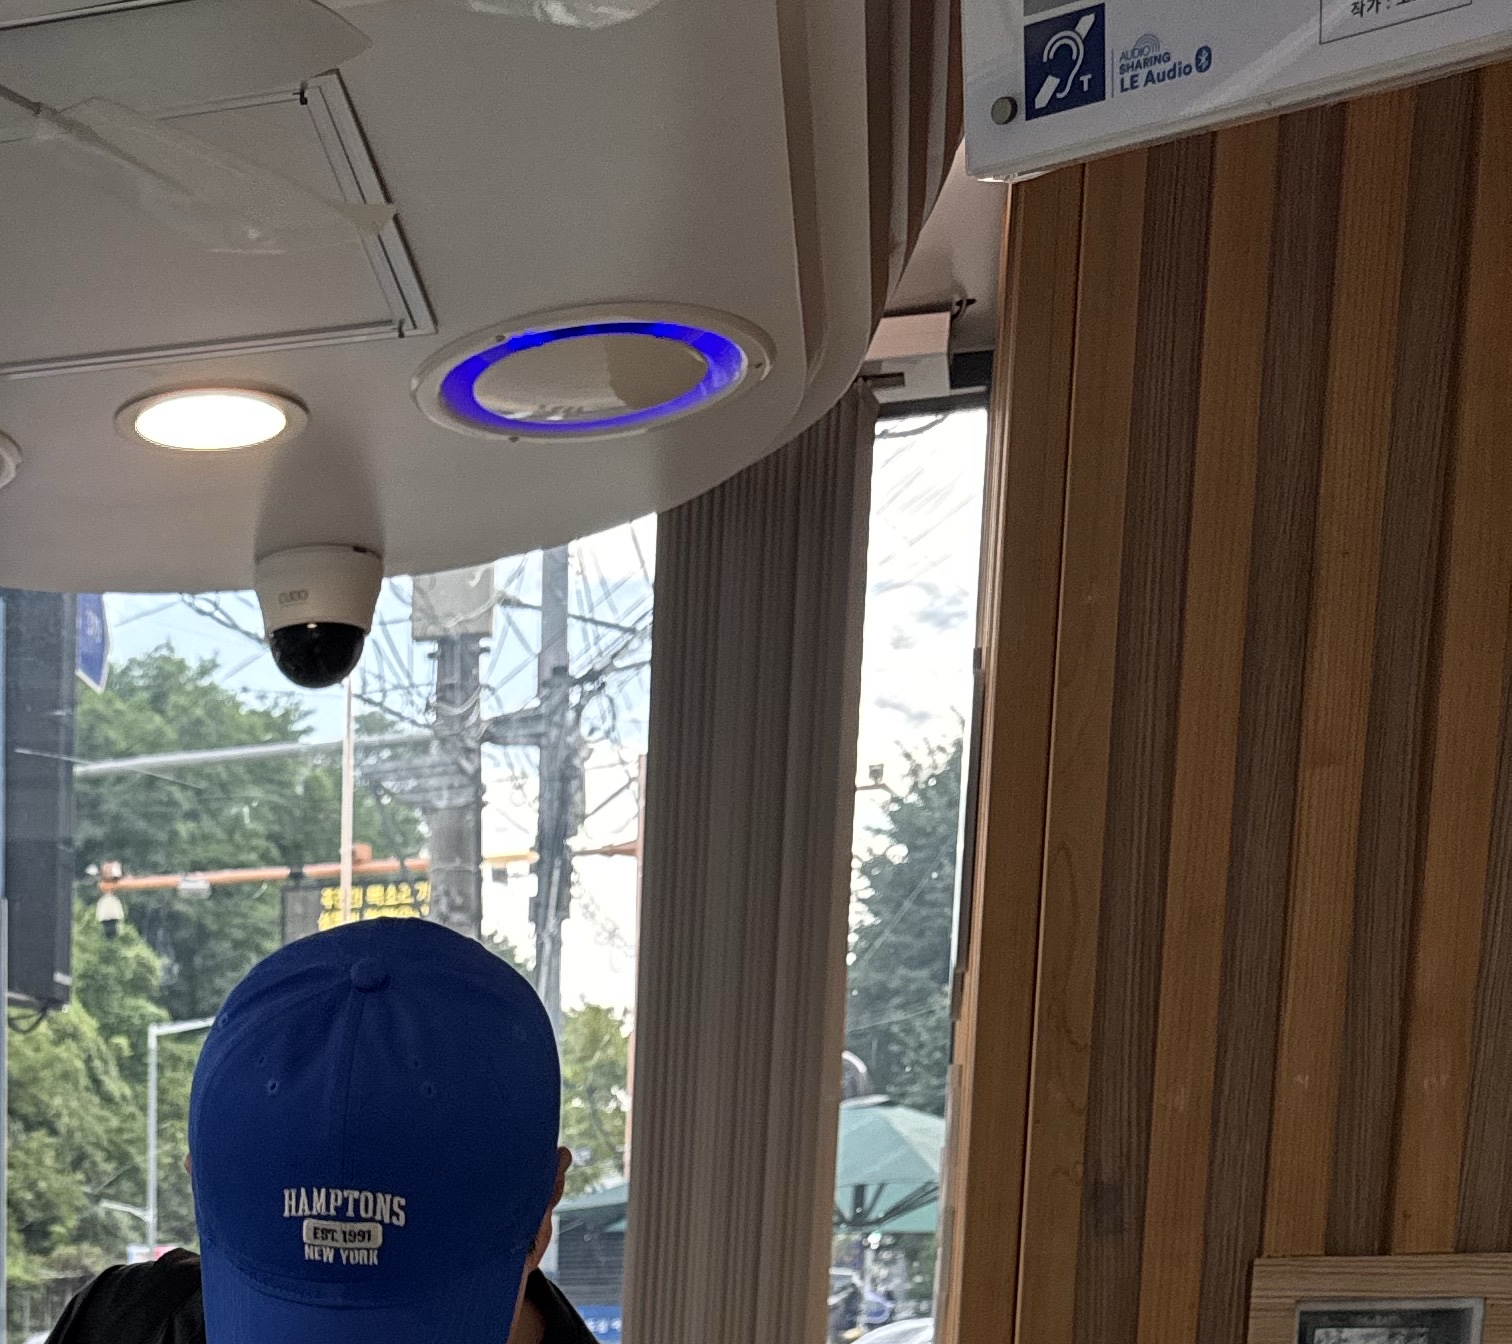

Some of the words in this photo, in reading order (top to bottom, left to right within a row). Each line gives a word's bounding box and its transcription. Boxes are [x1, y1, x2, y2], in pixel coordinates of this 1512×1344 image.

[1119, 45, 1151, 62] AUDIO
[1119, 51, 1171, 75] SHARING
[1120, 74, 1140, 93] LE
[1143, 61, 1193, 87] Audio
[283, 1187, 407, 1228] HAMPTONS
[312, 1227, 338, 1242] EST.
[341, 1228, 372, 1243] 1991
[304, 1244, 335, 1263] NEW
[341, 1245, 379, 1266] YORK
